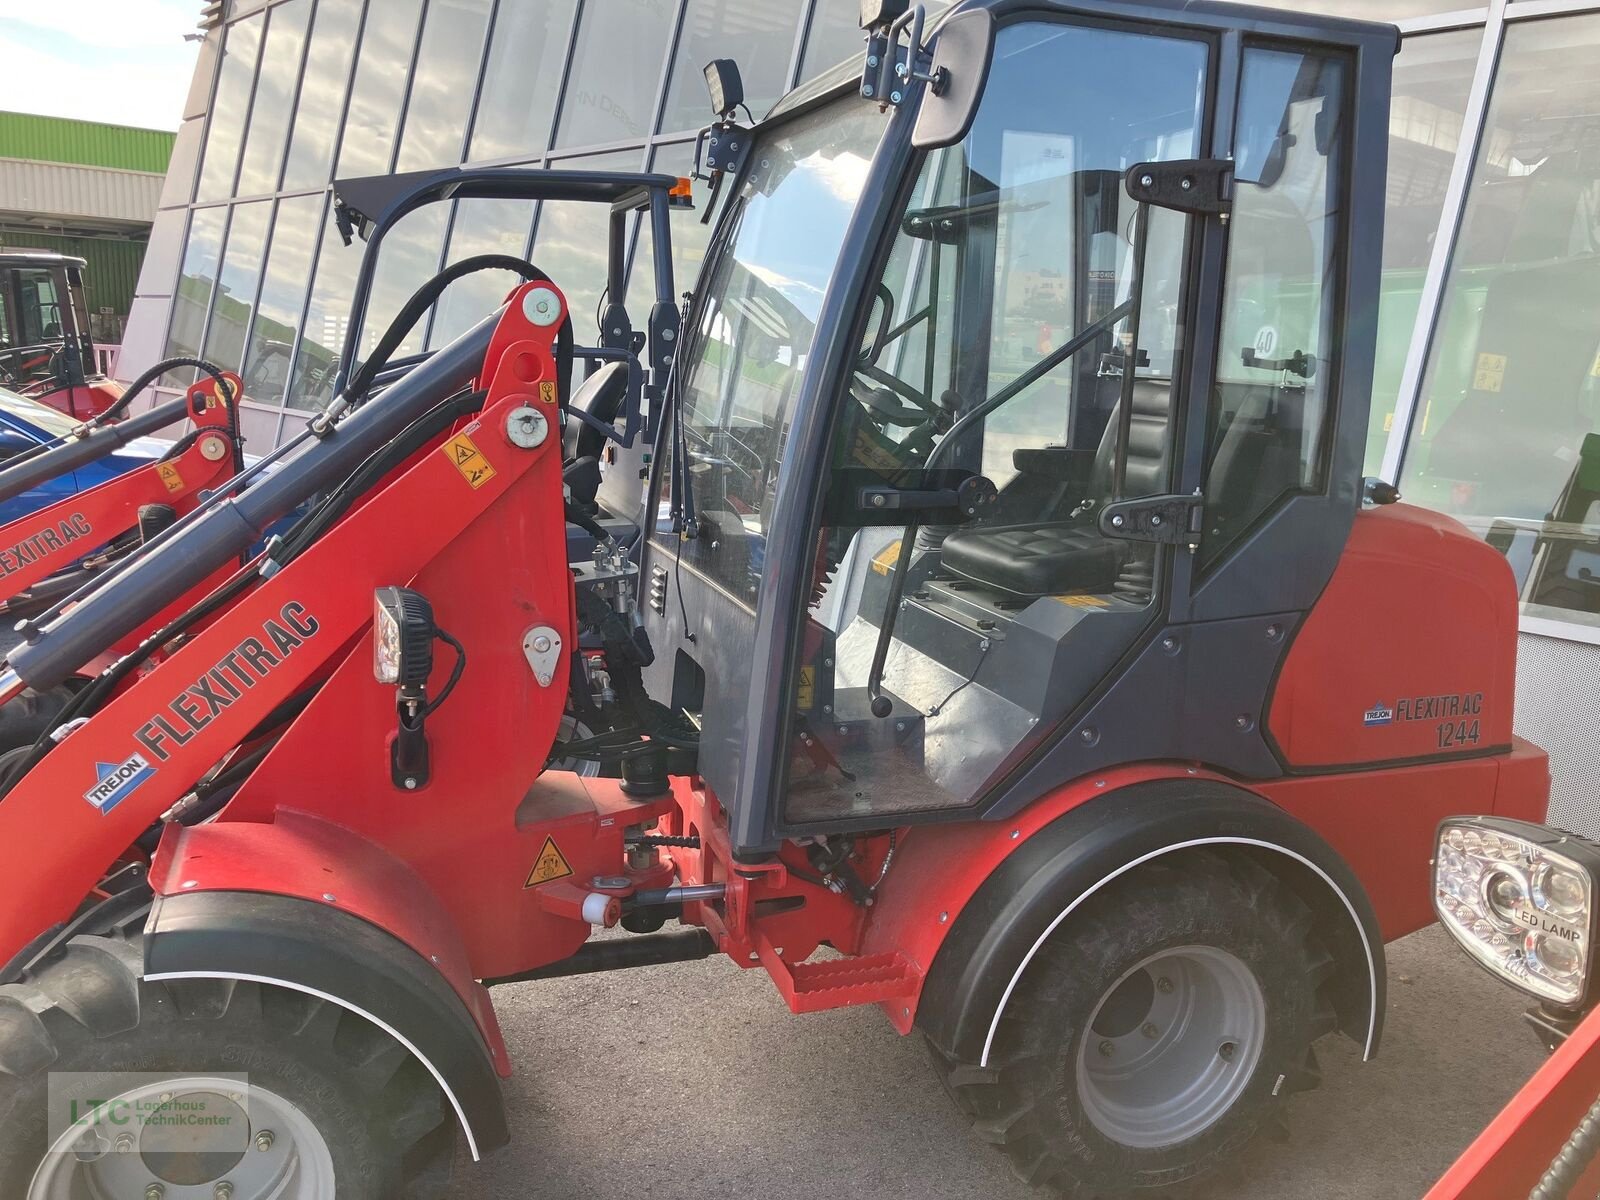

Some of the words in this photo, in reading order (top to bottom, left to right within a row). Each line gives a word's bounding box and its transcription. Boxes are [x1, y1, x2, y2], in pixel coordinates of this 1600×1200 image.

[1256, 330, 1273, 353] 40
[0, 512, 92, 580] EXITRAC
[132, 600, 320, 762] FLEXITRAC
[1366, 710, 1391, 720] TREJON
[1396, 691, 1482, 721] FLEXITRAC
[1436, 719, 1480, 748] 1244
[90, 756, 144, 803] TREJON
[1514, 907, 1538, 926] LED
[1542, 919, 1581, 942] LAMP
